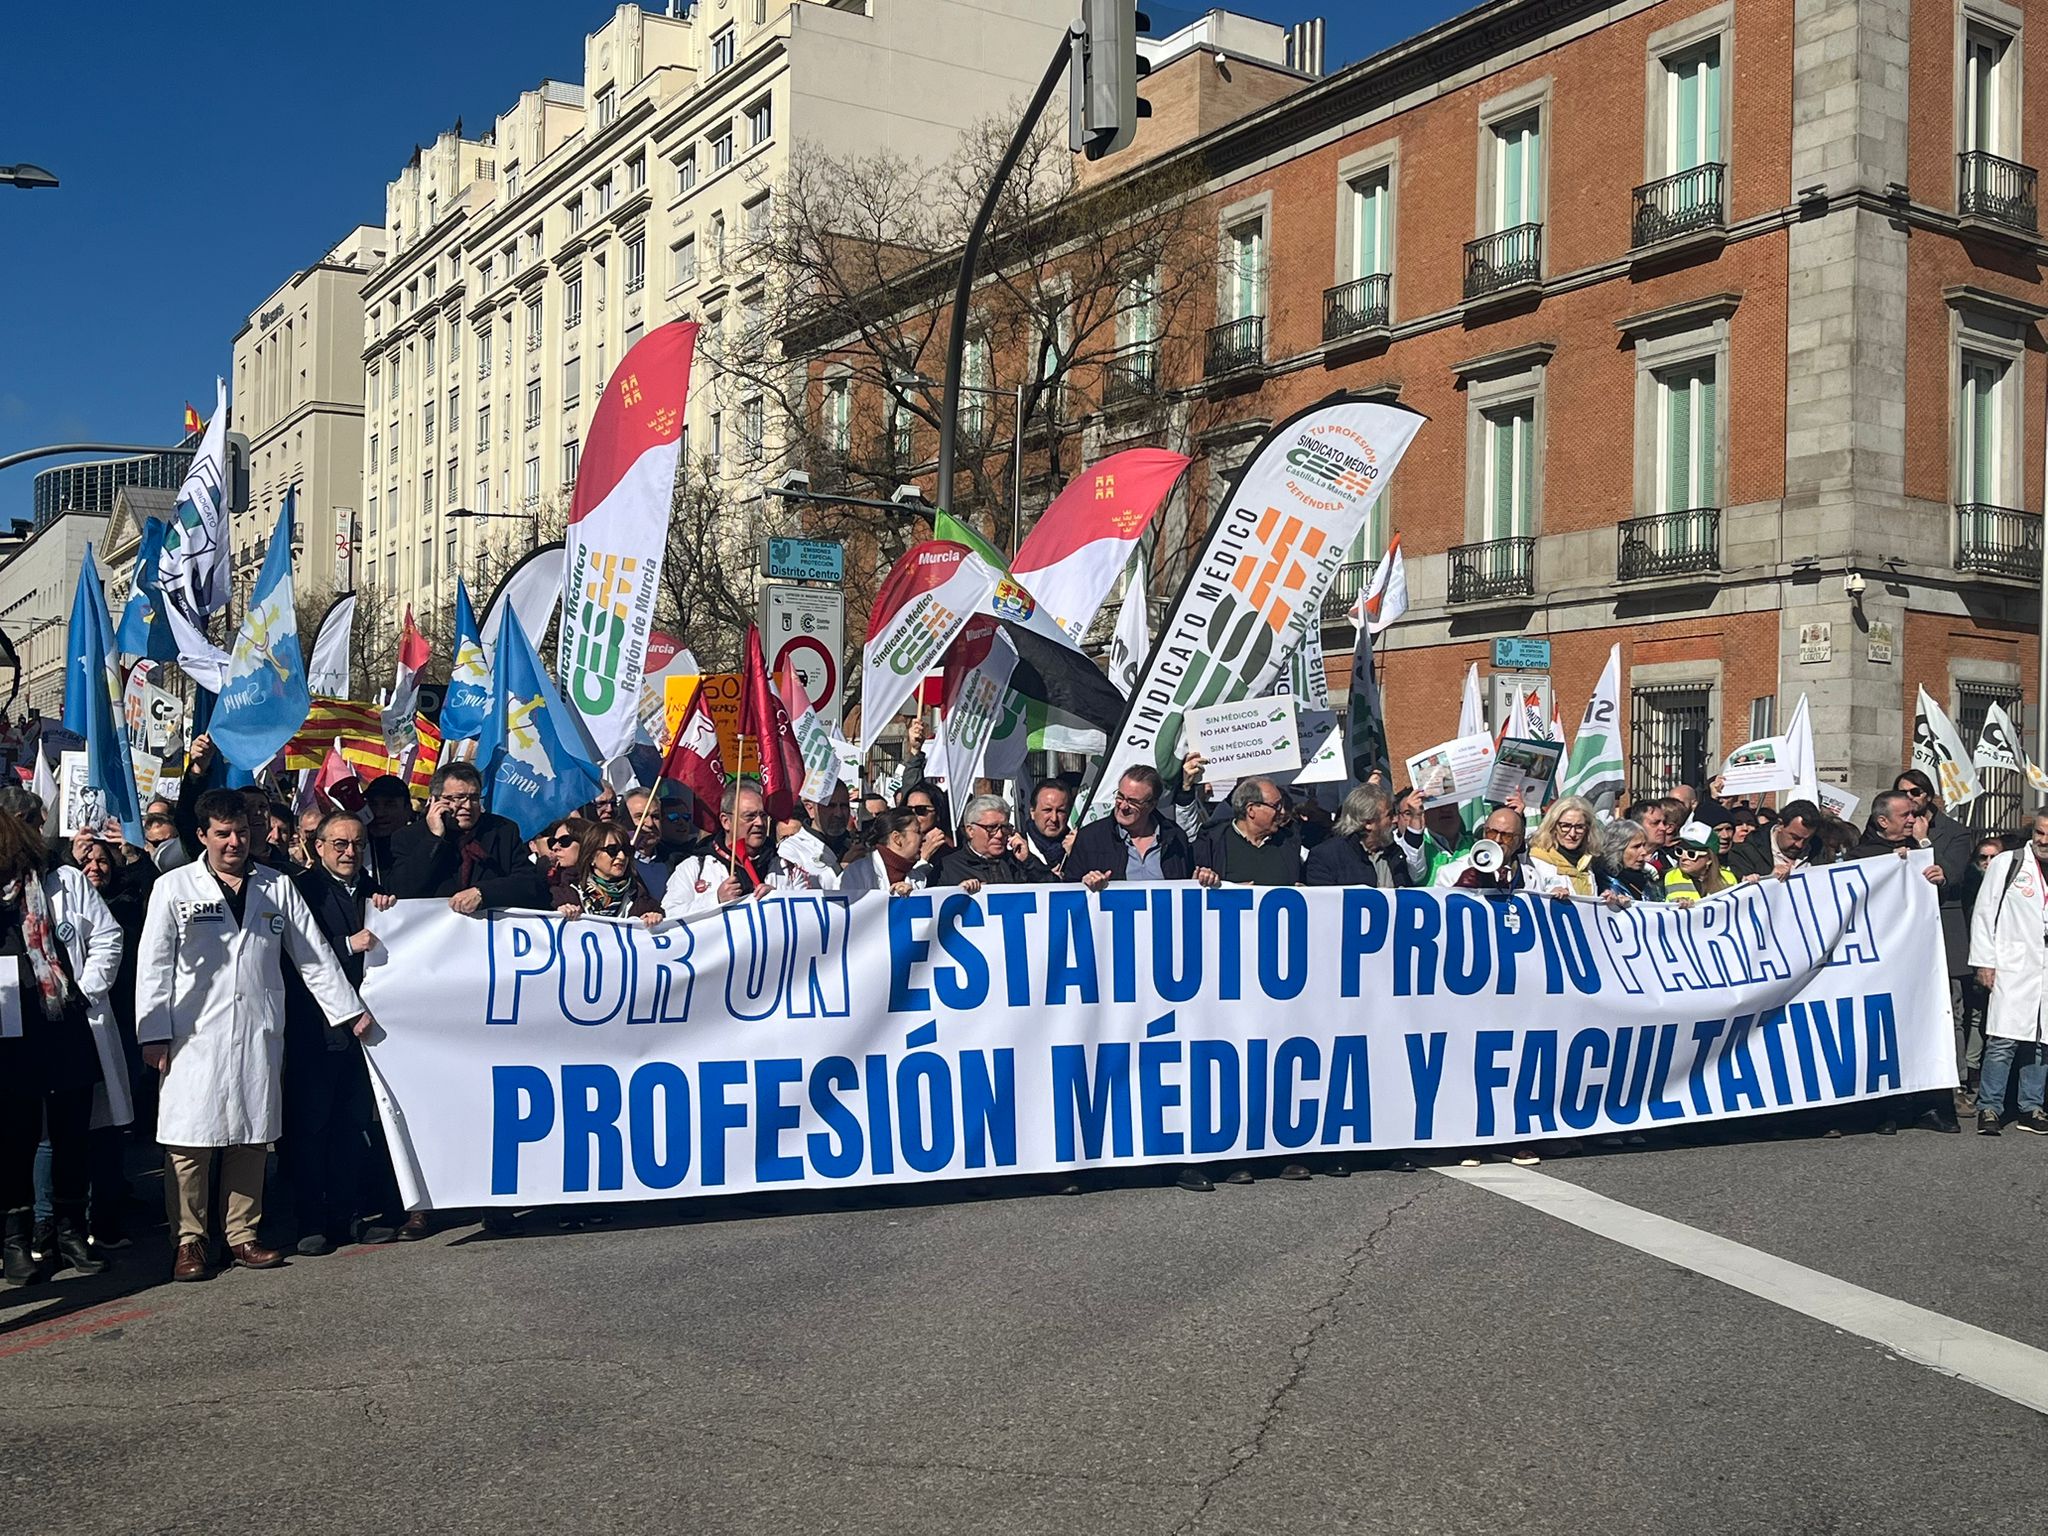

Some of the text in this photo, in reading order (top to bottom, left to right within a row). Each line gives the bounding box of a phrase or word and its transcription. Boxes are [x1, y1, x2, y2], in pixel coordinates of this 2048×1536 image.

[1297, 434, 1379, 480] SINDICATO MÉDICO
[1309, 425, 1377, 464] TU PROFESIÓN
[194, 487, 217, 529] SINDICATO
[1286, 479, 1345, 511] DEFIÉNDELA
[1327, 483, 1358, 504] Mancha
[771, 565, 840, 580] Distrito Centro
[918, 550, 960, 566] Murcia
[568, 543, 588, 622] Médico
[1288, 543, 1344, 636] Mancha
[620, 558, 658, 694] Región de Murcia
[872, 592, 934, 668] Sindicato Médico
[916, 617, 964, 673] Región de Murcia
[1127, 507, 1259, 750] SINDICATO MÉDICO
[647, 643, 675, 655] urcia
[1498, 658, 1548, 668] Distrito Centro
[949, 701, 969, 745] Sindicato
[1200, 720, 1268, 738] NO HAY SANIDAD
[1205, 715, 1220, 725] SIN
[1222, 709, 1260, 722] MÉDICOS
[1210, 743, 1225, 753] SIN
[1226, 738, 1264, 751] MÉDICOS
[1218, 754, 1234, 763] HAY
[1235, 748, 1272, 761] SANIDAD
[193, 903, 224, 915] SME
[486, 908, 695, 1026] POR
[722, 896, 851, 1021] UN
[888, 888, 1308, 1013] ESTATUTO
[1341, 888, 1602, 998] PROPIO
[1595, 877, 1791, 994] PARA
[491, 992, 1902, 1196] PROFESIÓN MÉDICA Y FACULTATIVA
